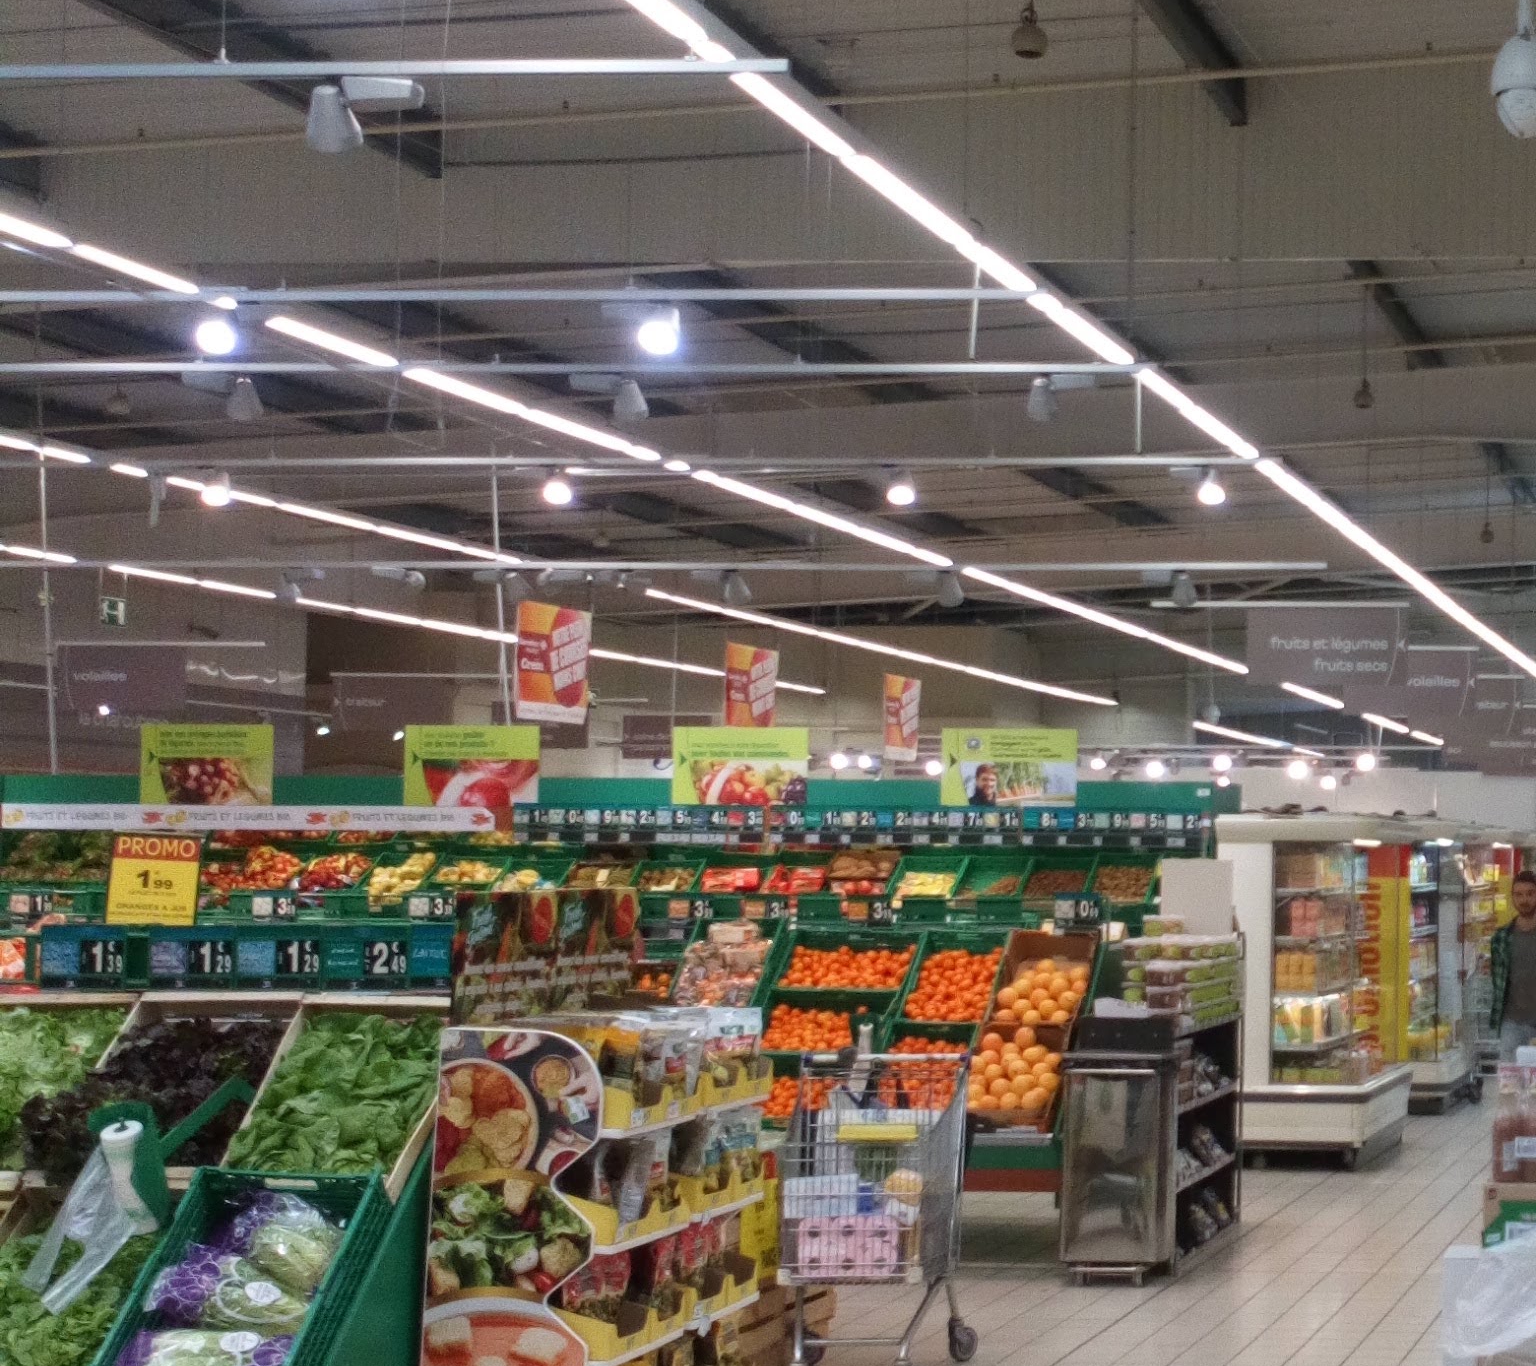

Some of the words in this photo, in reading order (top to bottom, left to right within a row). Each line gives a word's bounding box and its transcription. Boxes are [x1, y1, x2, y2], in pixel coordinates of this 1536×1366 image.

[1270, 636, 1310, 650] fruits
[1312, 638, 1329, 650] et
[1331, 636, 1389, 653] légumes
[117, 836, 197, 858] PROMO
